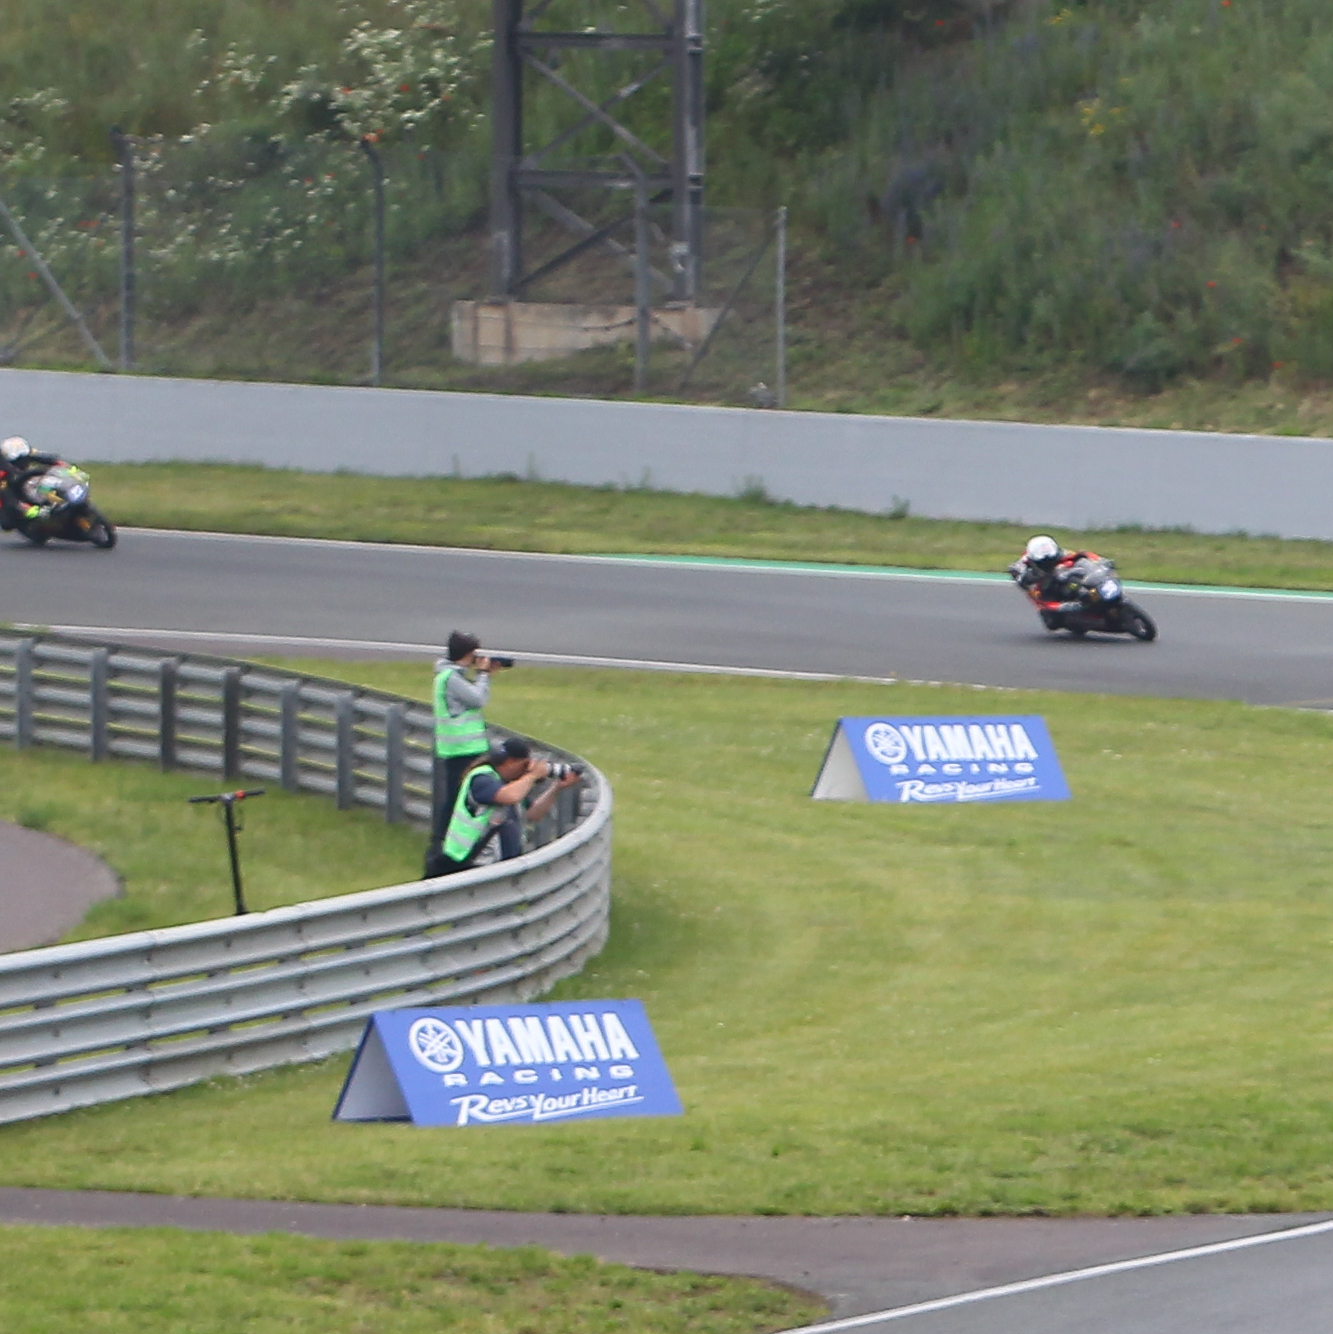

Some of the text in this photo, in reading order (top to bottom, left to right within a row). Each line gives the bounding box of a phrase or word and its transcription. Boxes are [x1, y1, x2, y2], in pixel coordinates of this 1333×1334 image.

[900, 724, 1039, 762] YAMAHA
[889, 763, 1034, 775] RACING
[455, 1012, 640, 1067] YAMAHA
[443, 1065, 634, 1087] RACING
[450, 1084, 637, 1126] Revs Your Heart
